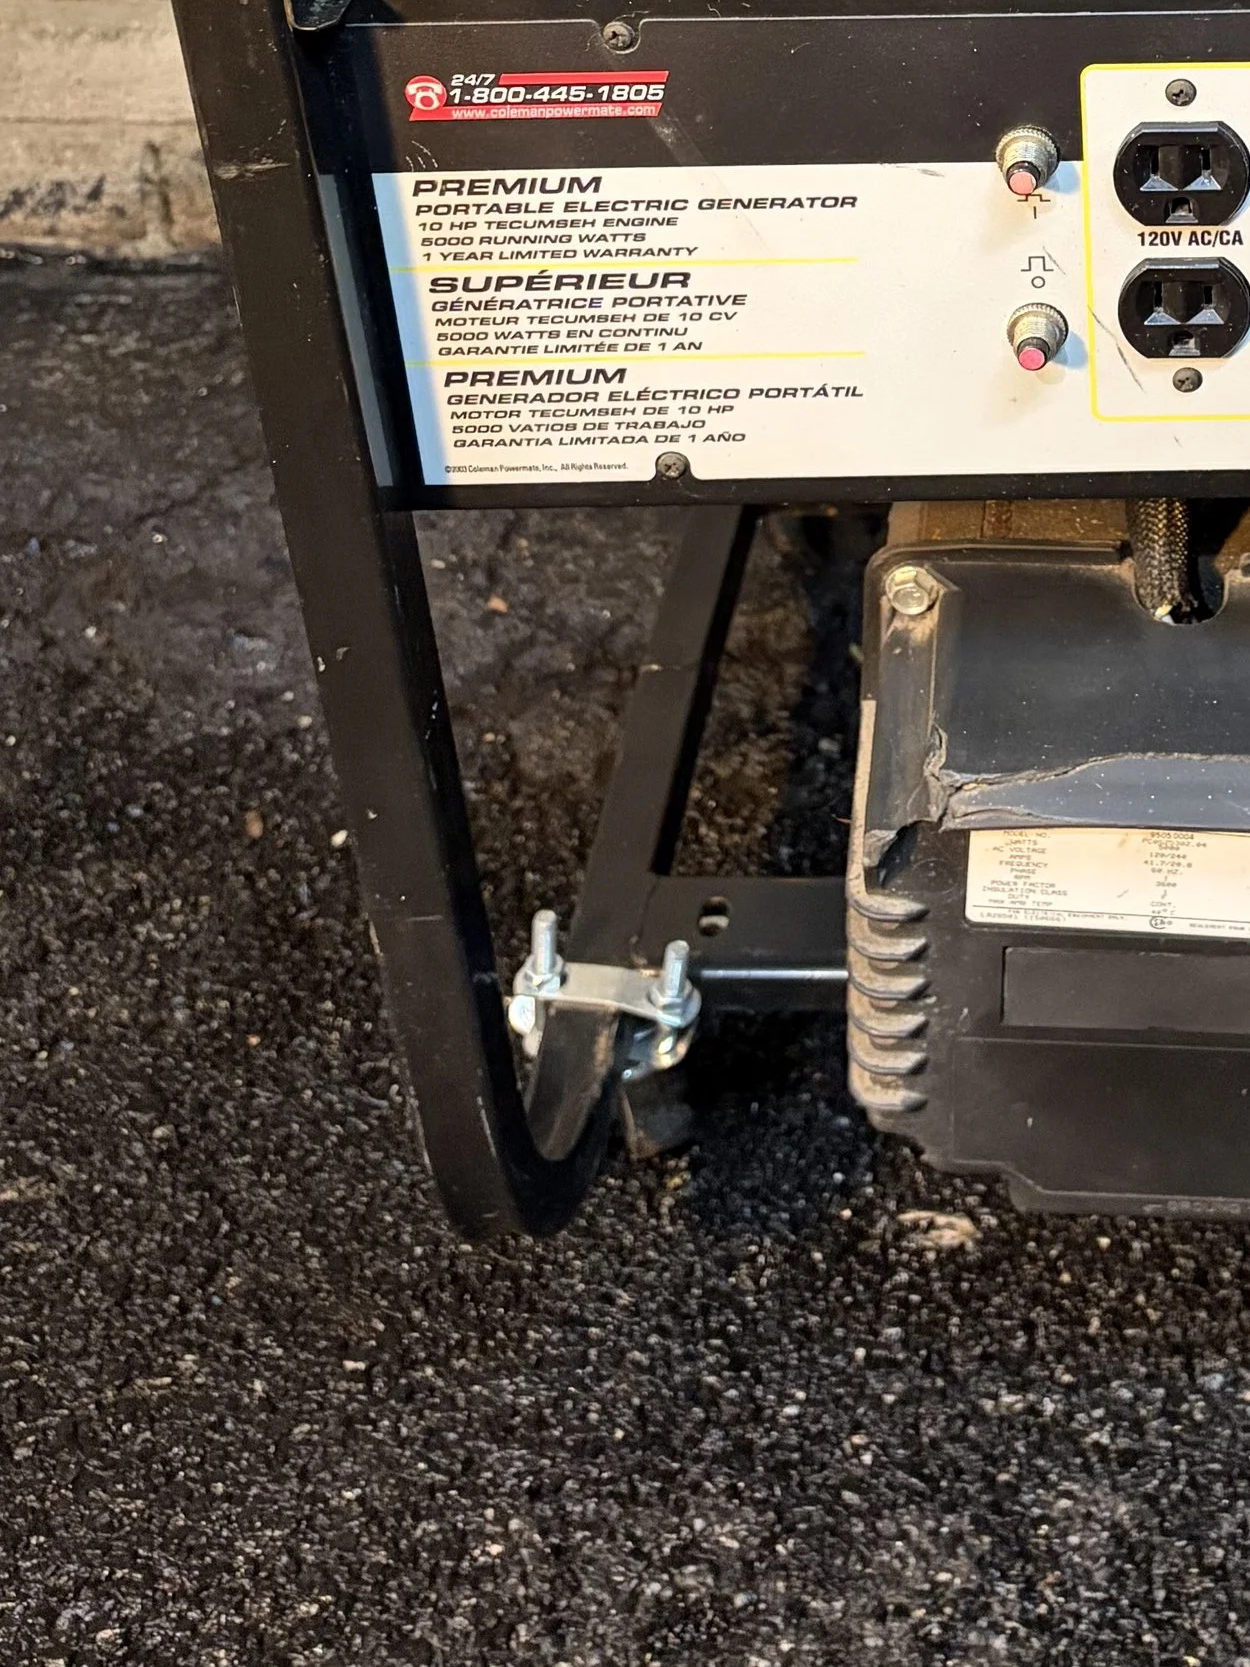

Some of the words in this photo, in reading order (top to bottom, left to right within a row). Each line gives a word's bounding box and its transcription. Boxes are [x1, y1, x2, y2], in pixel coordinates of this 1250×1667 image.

[452, 73, 496, 86] 24/7
[449, 84, 665, 104] 1-800-445-1805
[452, 103, 658, 119] www.colemanpowermate.com
[412, 177, 602, 197] PREMIUM
[416, 202, 554, 216] PORTABLE
[563, 199, 688, 213] ELECTRIC
[698, 197, 857, 210] GENERATOR
[419, 222, 442, 231] 10
[450, 221, 477, 230] HP
[484, 219, 596, 230] TECUMSEH
[603, 217, 678, 227] ENGINE
[421, 237, 473, 246] 5000
[479, 235, 572, 245] RUNNING
[579, 233, 646, 243] WATTS
[1138, 231, 1182, 246] 120V
[1188, 230, 1243, 247] AC/CA
[423, 253, 431, 261] 1
[440, 252, 493, 261] YEAR
[499, 250, 577, 260] LIMITED
[584, 247, 698, 258] WARRANTY
[429, 270, 691, 293] SUPÉRIEUR
[432, 296, 603, 312] GÉNÉRATRICE
[612, 294, 747, 308] PORTATIVE
[435, 317, 519, 326] MOTEUR
[527, 314, 636, 324] TECUMSEH
[643, 313, 670, 322] DE
[679, 313, 702, 321] 10
[709, 312, 737, 321] CV
[437, 332, 488, 341] 5000
[494, 330, 560, 340] WATTS
[566, 329, 593, 338] EN
[599, 328, 688, 337] CONTINU
[438, 345, 538, 356] GARANTIE
[544, 341, 619, 353] LIMITÉE
[624, 343, 651, 351] DE
[658, 342, 666, 351] 1
[673, 342, 702, 350] AN
[444, 368, 627, 387] PREMIUM
[447, 391, 599, 405] GENERADOR
[608, 387, 740, 401] ELÉCTRICO
[749, 384, 863, 399] PORTÁTIL
[451, 410, 521, 419] MOTOR
[529, 407, 636, 418] TECUMSEH
[643, 407, 669, 415] DE
[678, 406, 701, 414] 10
[708, 405, 734, 414] HP
[452, 425, 502, 433] 5000
[509, 423, 577, 432] VATIOS
[583, 422, 609, 431] DE
[615, 420, 706, 430] TRABAJO
[454, 438, 552, 447] GARANTIA
[559, 435, 648, 445] LIMITADA
[655, 435, 681, 443] DE
[688, 434, 696, 443] 1
[703, 432, 745, 442] AÑO
[571, 463, 593, 472] Rights
[999, 860, 1048, 868] FREQUENCY
[982, 886, 1036, 894] INSULATION
